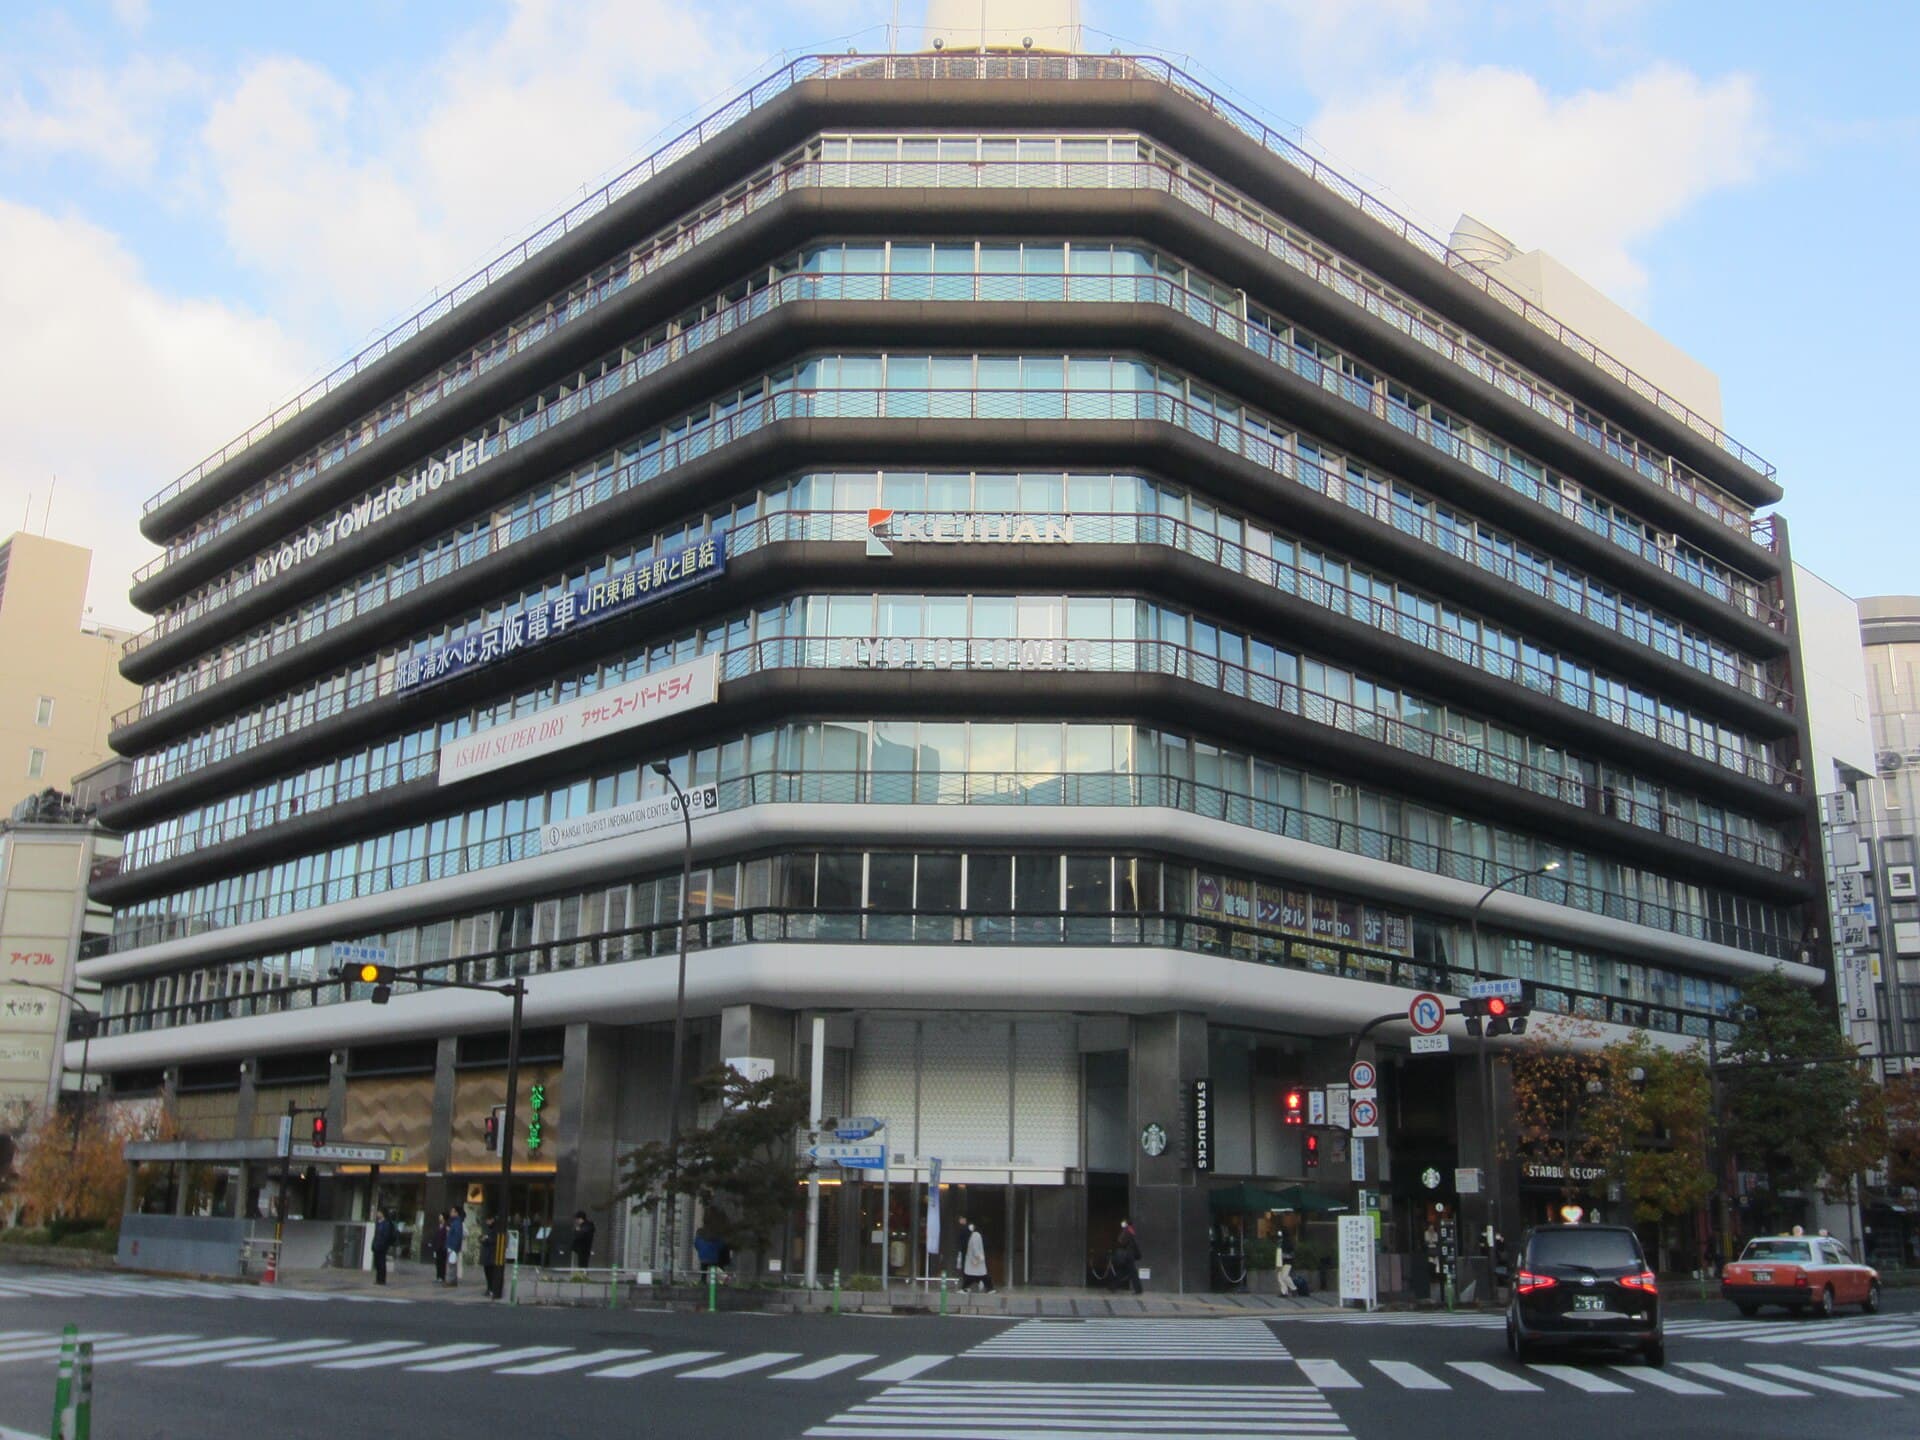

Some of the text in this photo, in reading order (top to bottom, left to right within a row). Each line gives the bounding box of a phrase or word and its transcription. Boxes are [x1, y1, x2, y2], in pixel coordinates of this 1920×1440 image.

[255, 438, 492, 585] KYOTO TOWER HOTEL
[902, 519, 1074, 544] KEIHAN
[840, 638, 1093, 671] KYOTO TOWER
[454, 715, 568, 769] ASAHI SUPER DRY
[561, 803, 670, 841] KANSAI TOURIST INFORMATION CENTER
[1311, 917, 1351, 937] wargo
[1365, 919, 1382, 941] 3F
[10, 952, 55, 966] アイフル
[1356, 1069, 1370, 1081] 40
[1197, 1081, 1207, 1169] STARBUCKS
[1528, 1165, 1580, 1179] STARBUKS
